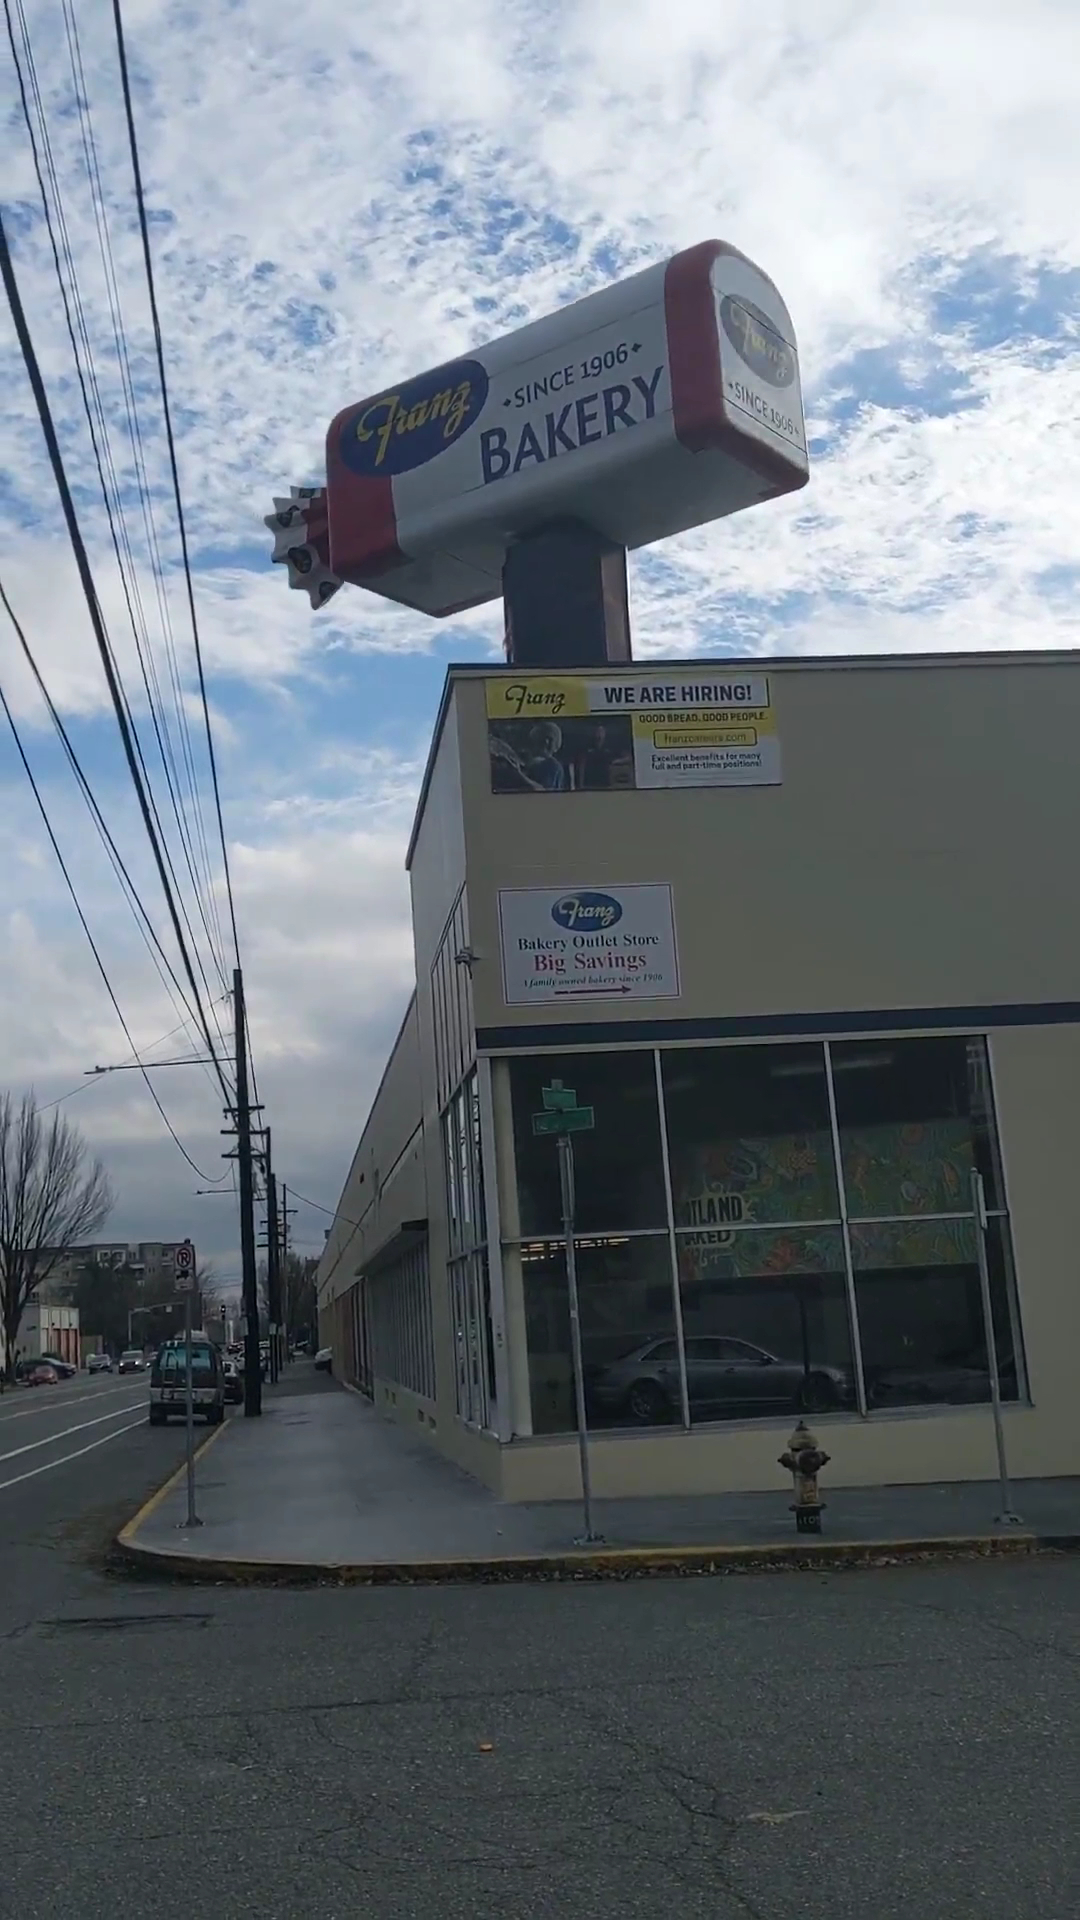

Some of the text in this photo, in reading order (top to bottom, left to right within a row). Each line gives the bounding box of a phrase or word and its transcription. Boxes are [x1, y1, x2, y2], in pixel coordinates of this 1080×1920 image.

[513, 348, 629, 408] SINCE 1906
[734, 381, 794, 435] SINCE 1906
[356, 378, 472, 466] Franz
[479, 365, 664, 485] BAKERY
[504, 684, 566, 714] Franz
[604, 684, 752, 704] WE ARE HIRING!
[639, 711, 768, 723] GOOD BREAD. GOOD PEOPLE.
[651, 754, 688, 763] Excellent
[690, 753, 725, 762] benefits
[739, 753, 762, 762] many
[651, 762, 665, 771] full
[666, 762, 682, 770] and
[683, 761, 722, 771] part-time
[558, 897, 616, 927] Franz
[518, 933, 660, 953] Bakery Outlet Store
[533, 951, 648, 975] Big Savings
[528, 978, 557, 989] family
[588, 974, 617, 985] bakery
[618, 974, 641, 983] since
